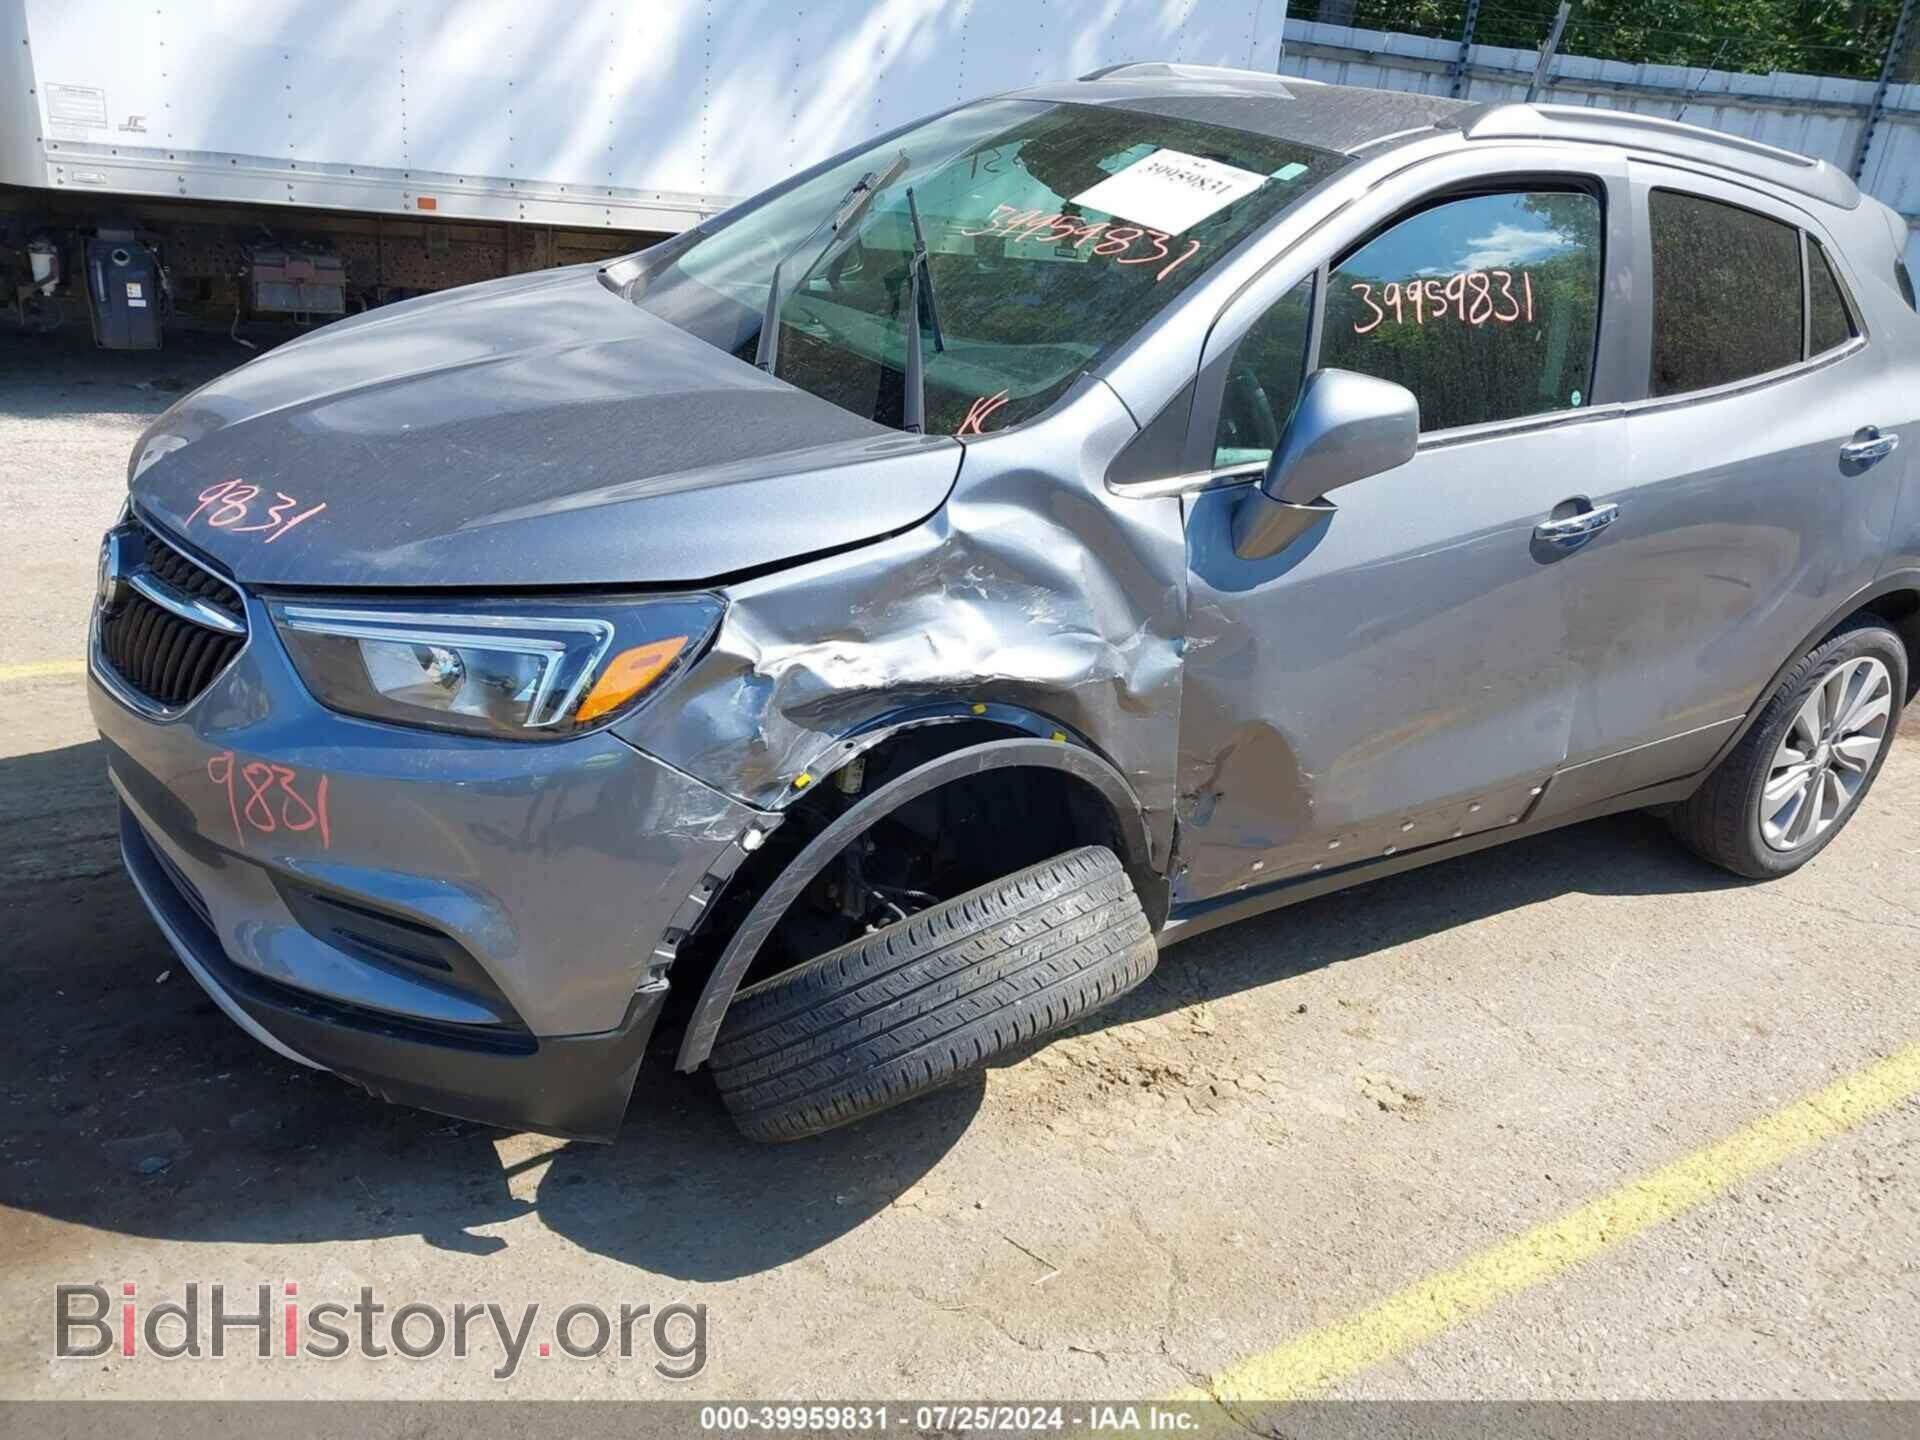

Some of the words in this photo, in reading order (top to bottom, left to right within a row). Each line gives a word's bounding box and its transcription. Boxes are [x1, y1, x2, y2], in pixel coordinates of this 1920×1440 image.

[1351, 271, 1533, 334] 39959831
[184, 478, 327, 543] 9831
[208, 751, 330, 848] 9831
